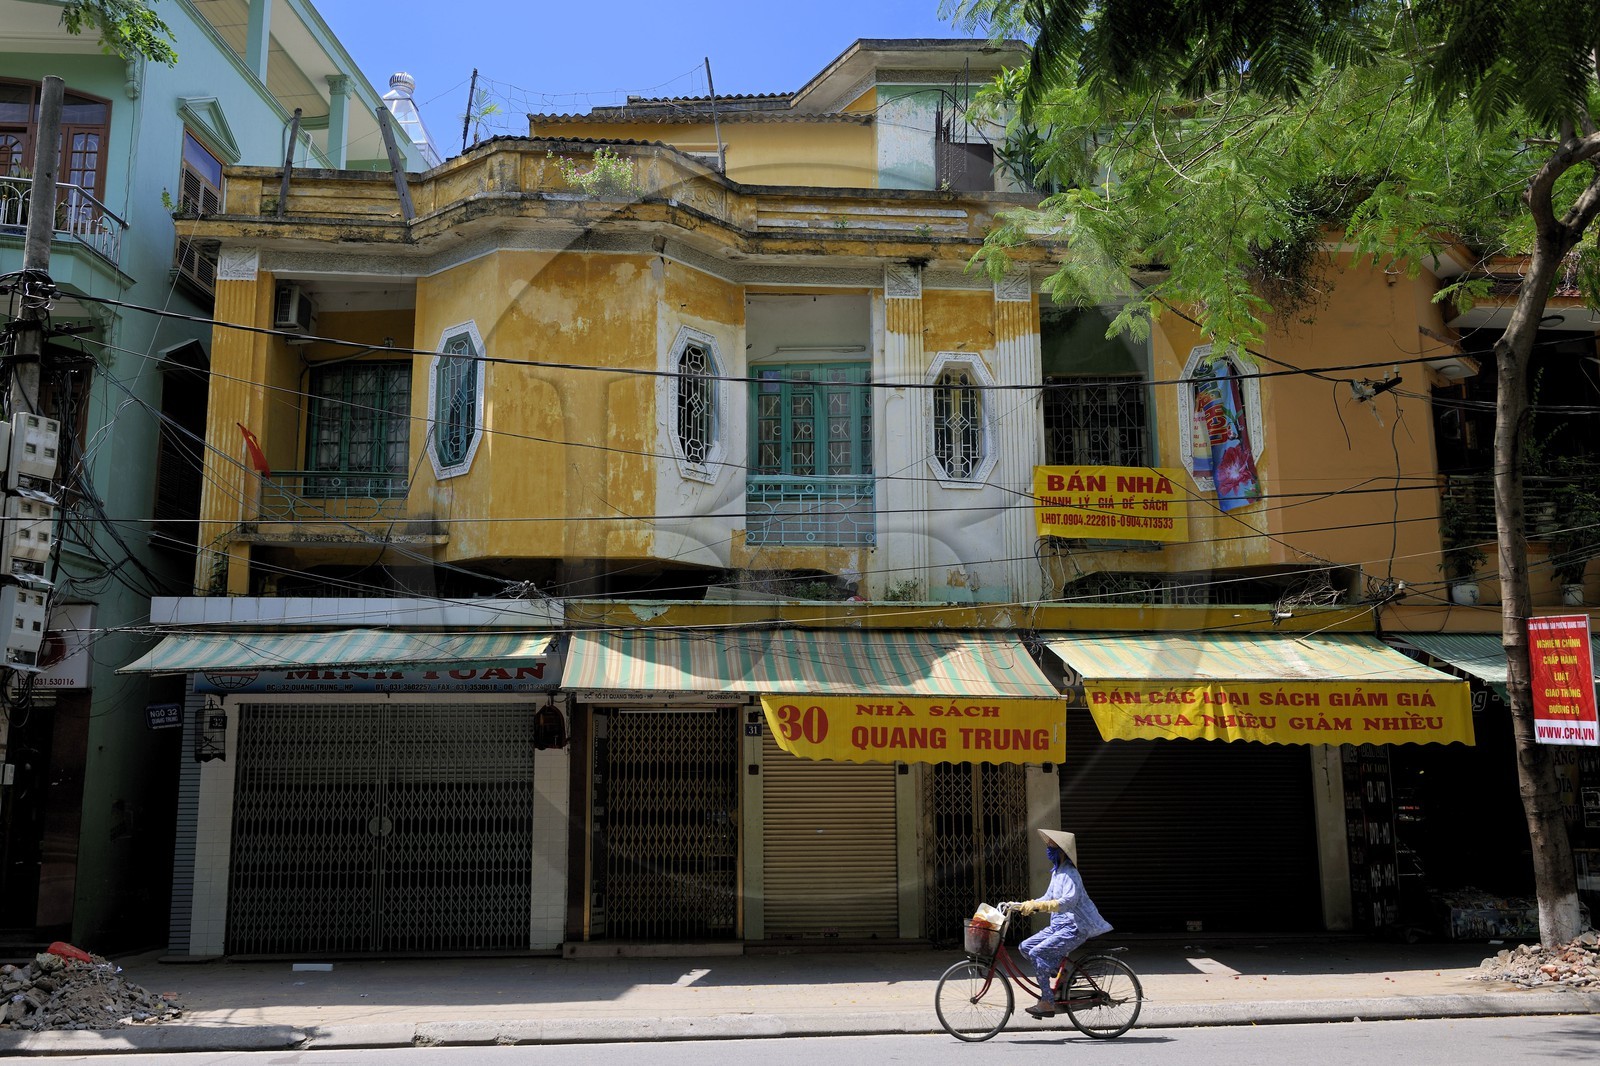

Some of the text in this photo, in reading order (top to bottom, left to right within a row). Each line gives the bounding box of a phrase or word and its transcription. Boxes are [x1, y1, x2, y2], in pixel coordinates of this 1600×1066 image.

[1047, 469, 1106, 492] BÁN
[1040, 495, 1071, 508] THANH
[1079, 494, 1090, 508] LÝ
[1098, 495, 1114, 509] GIÁ
[1142, 497, 1168, 511] SÁCH
[1536, 638, 1560, 649] NGHIÊM
[1560, 653, 1578, 664] HÀNH
[1554, 671, 1569, 683] LUẬT
[437, 683, 449, 691] FAX
[1545, 687, 1582, 698] GIAO THÔNG
[1092, 687, 1436, 708] BÁN CÁC LOẠI SÁCH GIẢM GIÁ
[167, 708, 178, 717] 32
[856, 700, 1000, 718] NHÀ SÁCH
[1549, 703, 1580, 717] ĐƯỜNG BỘ
[777, 704, 829, 744] 30
[1133, 711, 1444, 731] MUA NHIỀU GIẢM NHIỀU
[748, 725, 759, 735] 31
[1537, 726, 1595, 740] WWW.CPN.VN
[851, 726, 1050, 751] QUANG TRUNG
